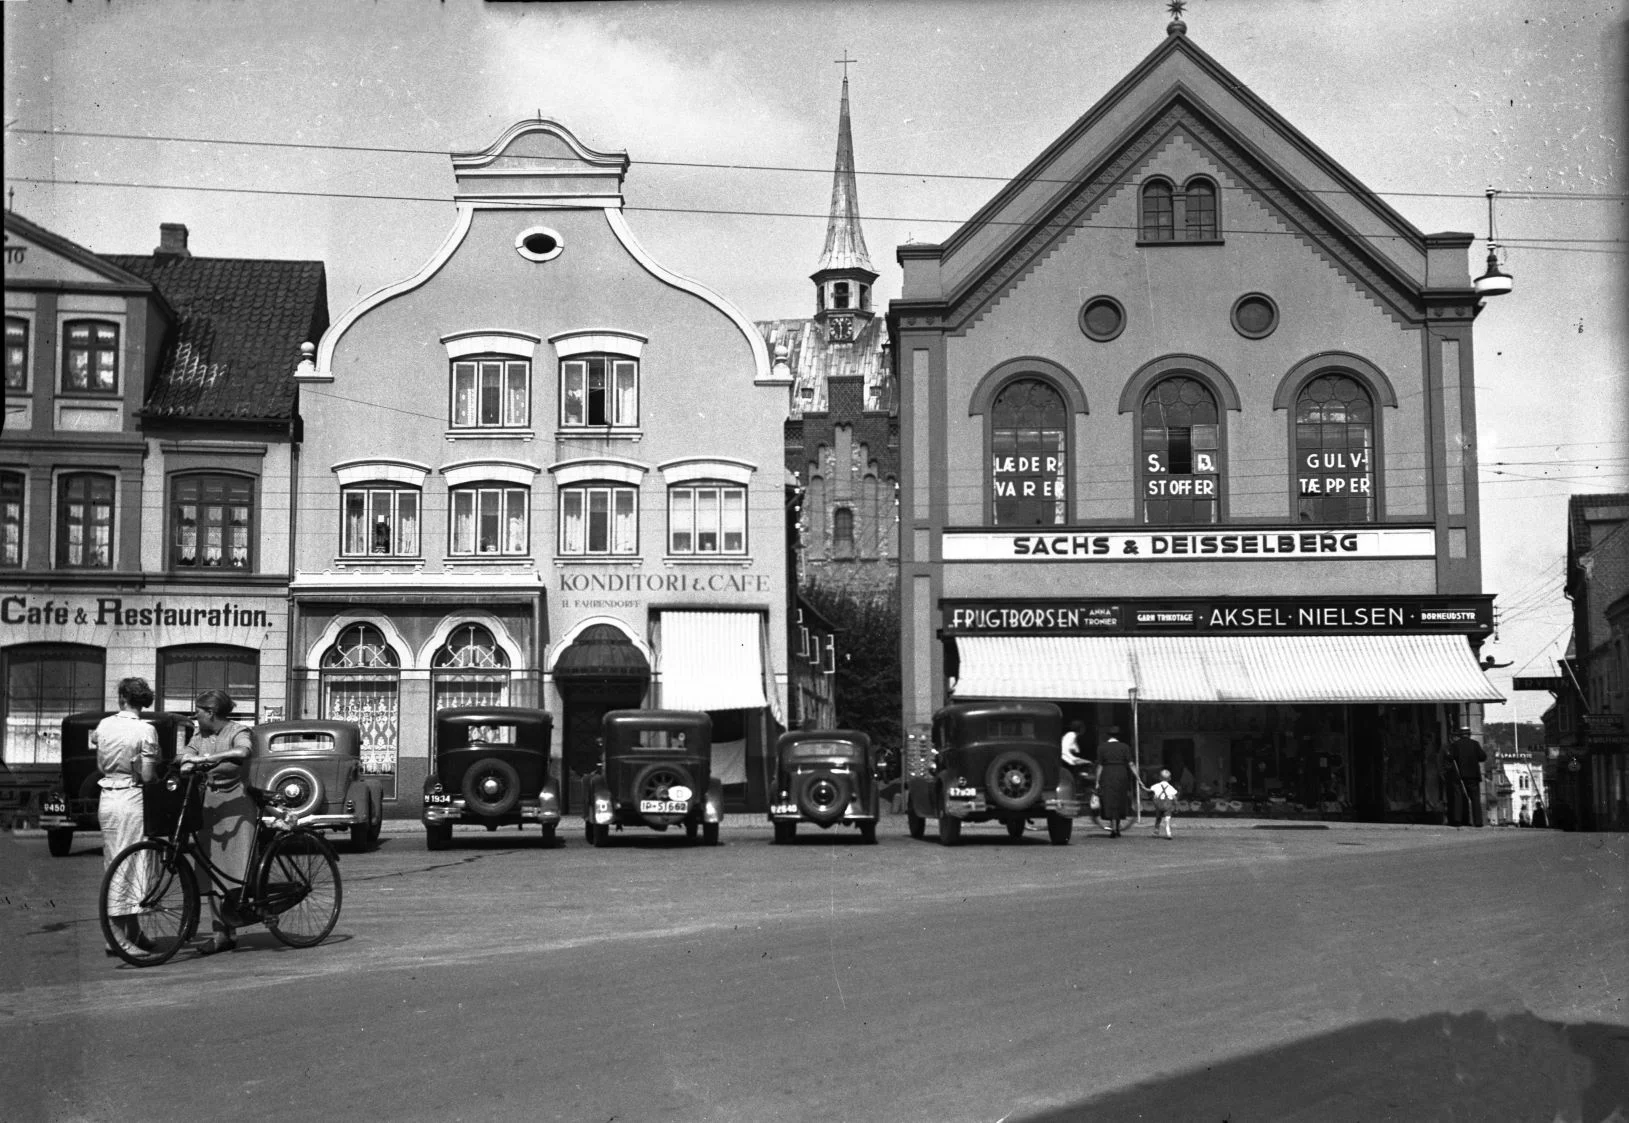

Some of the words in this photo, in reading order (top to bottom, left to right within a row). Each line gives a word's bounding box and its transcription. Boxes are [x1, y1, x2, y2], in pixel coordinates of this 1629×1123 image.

[995, 481, 1065, 496] VARER
[1148, 479, 1214, 495] STOFFER
[1299, 477, 1370, 493] TÆPPER
[1013, 536, 1110, 555] SACHS
[1122, 539, 1140, 555] &
[1150, 533, 1359, 554] DEISSELBERG
[560, 574, 687, 592] KONDITORI
[1, 595, 69, 625] Café
[74, 607, 89, 625] &
[1299, 608, 1404, 626] NIELSEN
